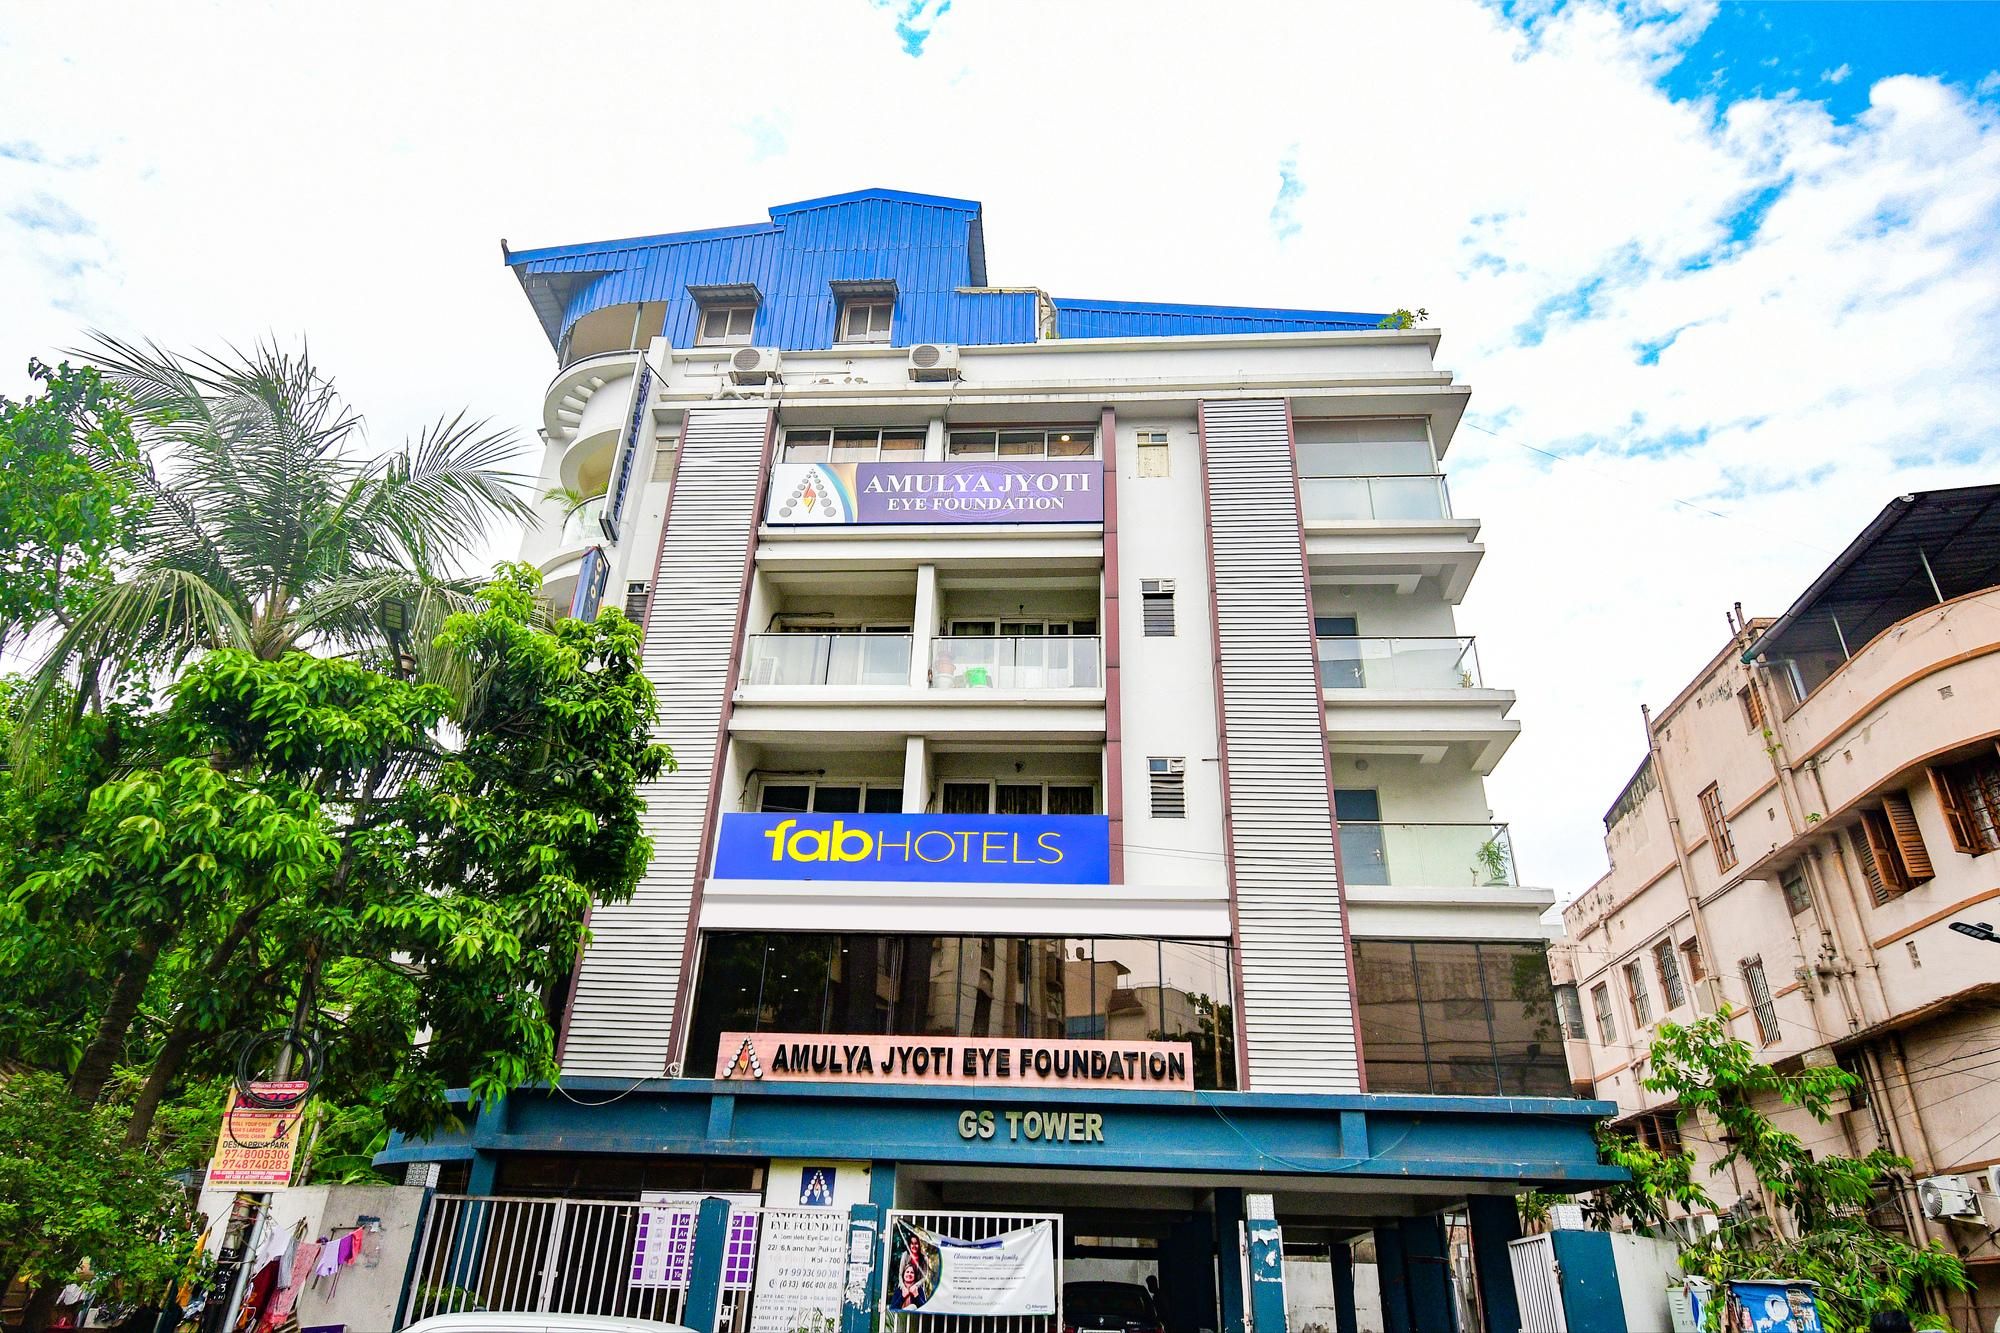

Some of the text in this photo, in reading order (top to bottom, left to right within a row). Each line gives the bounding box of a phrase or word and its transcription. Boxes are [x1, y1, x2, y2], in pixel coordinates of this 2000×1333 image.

[864, 472, 1092, 494] AMULYA JYOTI
[887, 496, 1065, 511] EYE FOUNDATION
[590, 558, 602, 599] OYO
[772, 1043, 1185, 1080] AMULYA JYOTI EYE FOUNDATION
[958, 1110, 1104, 1142] GS TOWER
[224, 1149, 290, 1159] 9748005306
[270, 1141, 290, 1149] PARK
[222, 1160, 289, 1169] 9748740283
